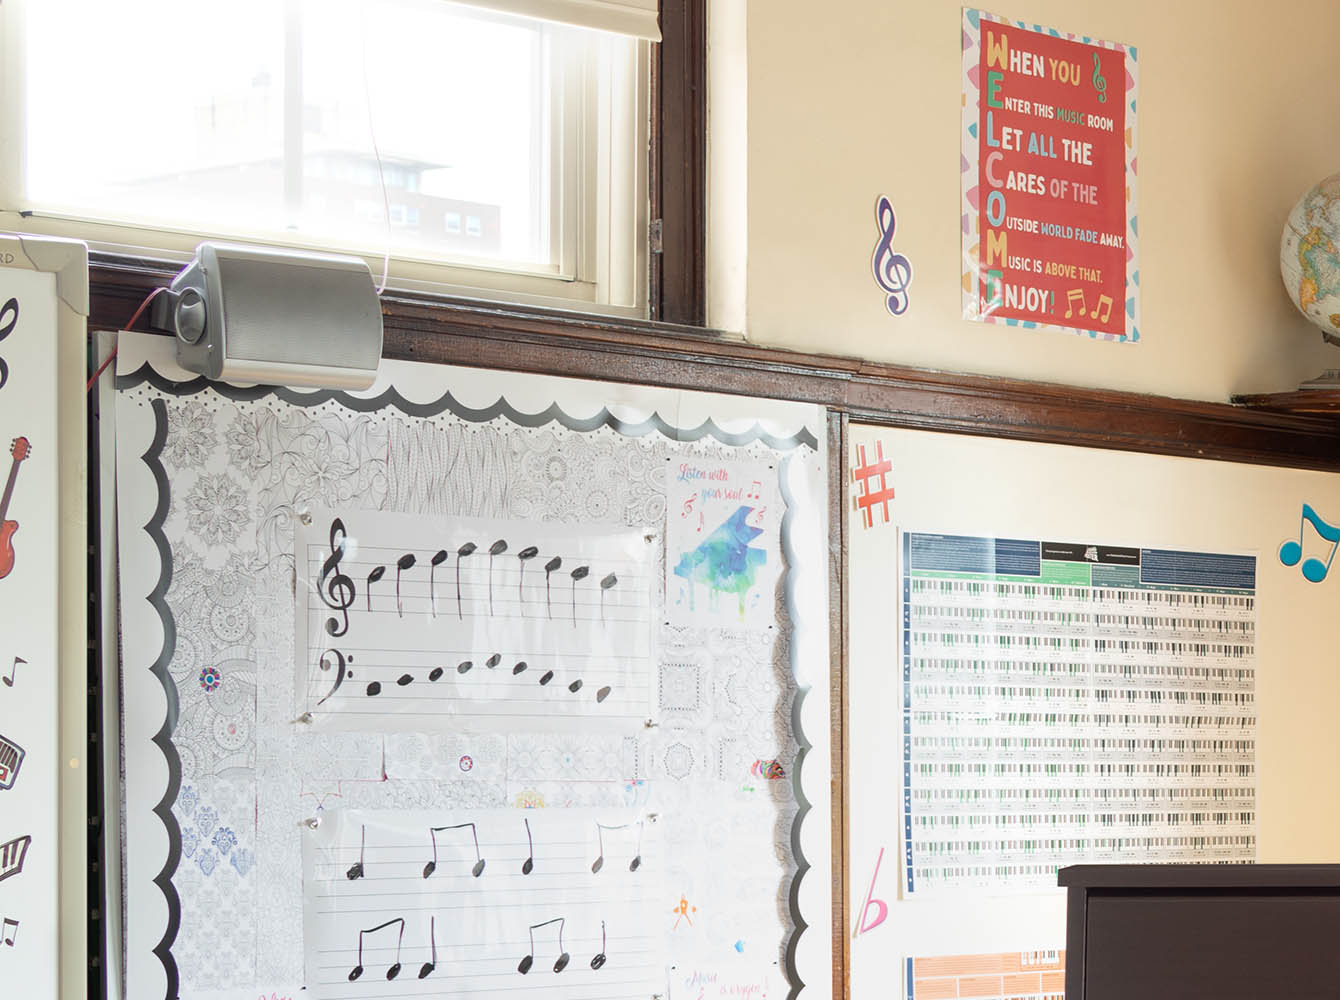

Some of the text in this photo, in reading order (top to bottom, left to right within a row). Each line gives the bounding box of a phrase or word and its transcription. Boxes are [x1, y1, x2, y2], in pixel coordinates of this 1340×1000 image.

[987, 31, 1080, 85] WHEN YOU
[987, 71, 1113, 132] ENTER THIS MUSIC ROOM
[986, 111, 1092, 166] LET ALL THE
[985, 151, 1097, 205] CARES OF THE
[986, 191, 1124, 248] OUTSIDE WORLD FADE AWAY.
[987, 229, 1102, 283] MUSIC IS ABOVE THAT.
